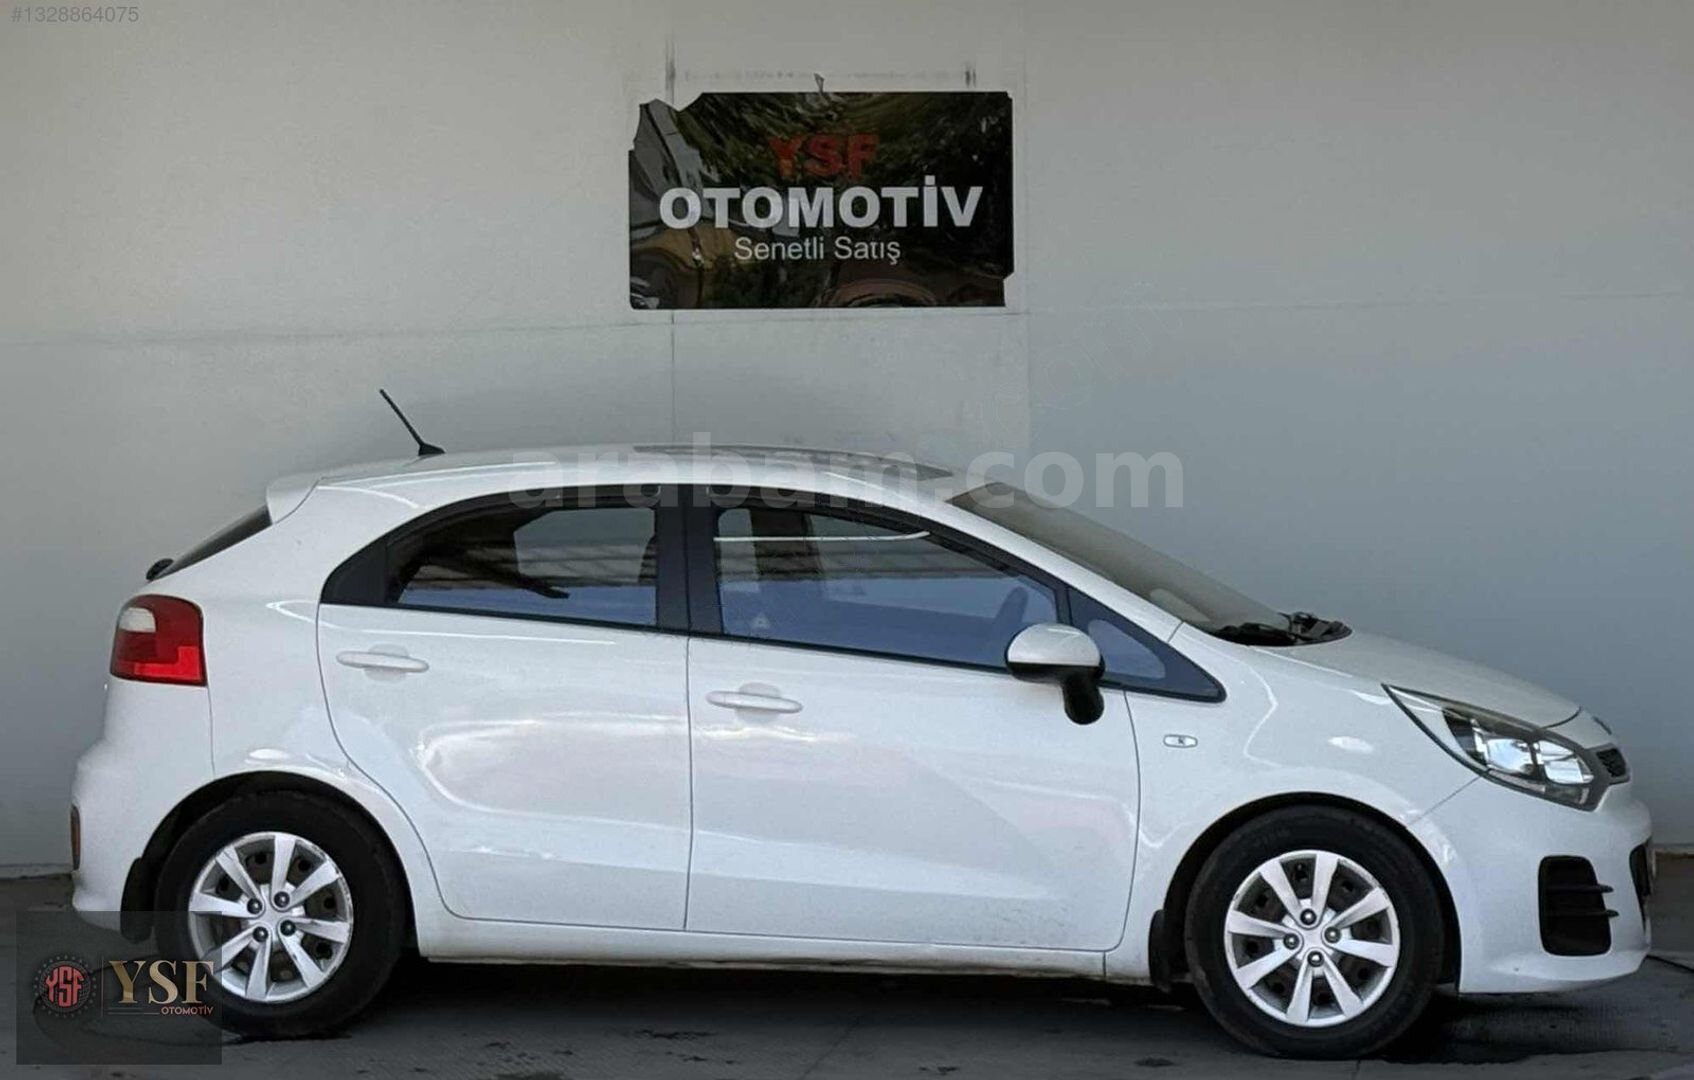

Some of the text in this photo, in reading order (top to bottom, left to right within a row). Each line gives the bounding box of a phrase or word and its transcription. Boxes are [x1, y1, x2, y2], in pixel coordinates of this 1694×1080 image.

[767, 133, 878, 178] YSF
[659, 175, 983, 229] OTOMOTİV
[734, 235, 901, 266] Senetli Satış
